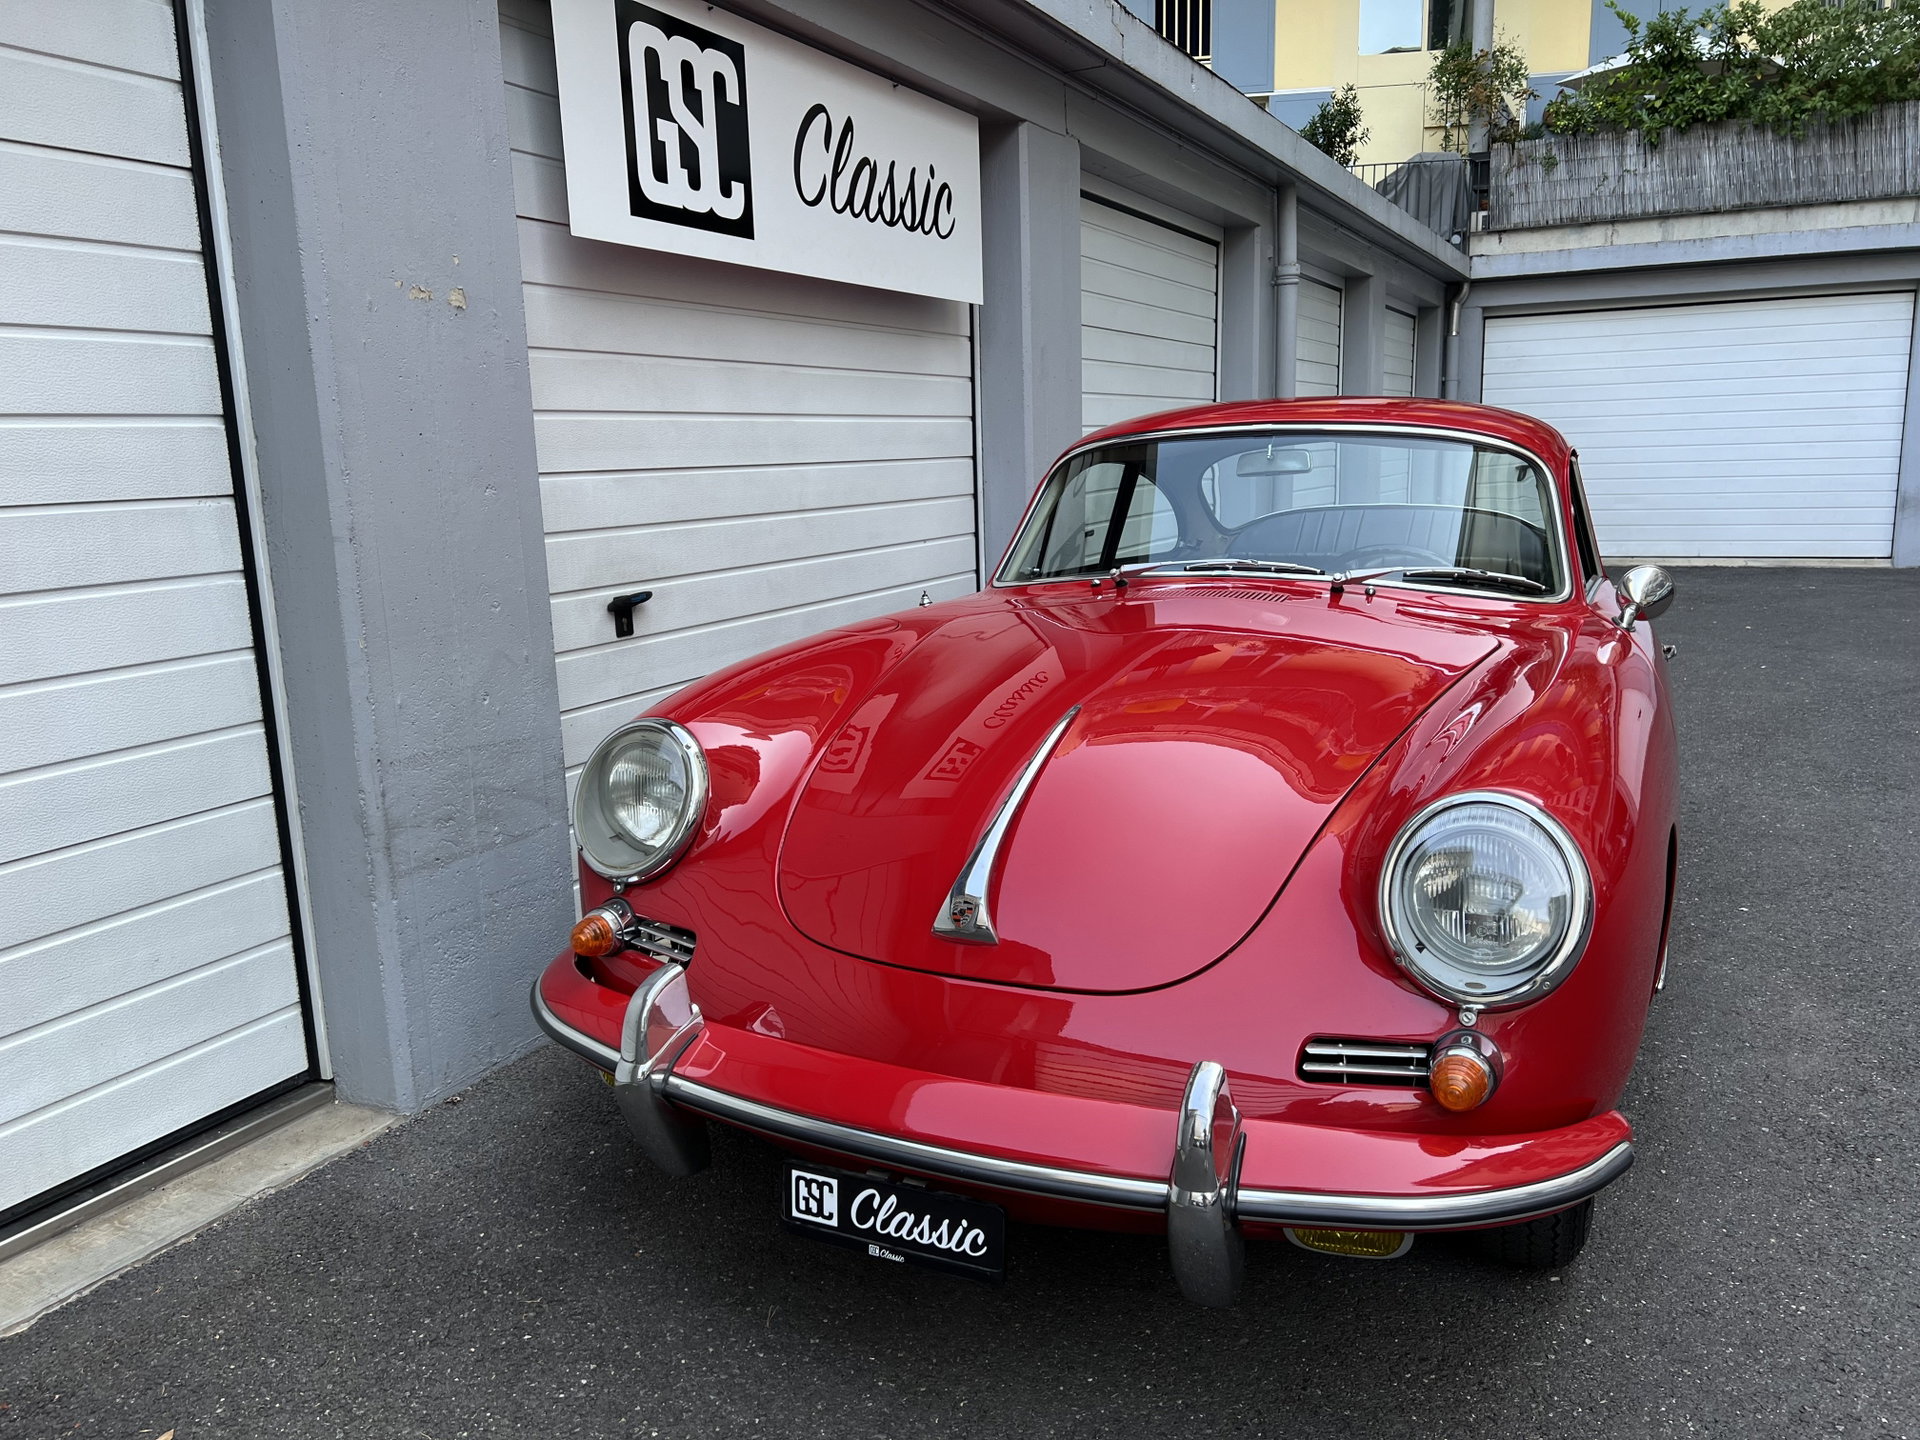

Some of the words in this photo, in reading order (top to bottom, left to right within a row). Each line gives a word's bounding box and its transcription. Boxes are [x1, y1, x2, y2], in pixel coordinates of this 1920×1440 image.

[628, 20, 745, 220] GSC
[793, 103, 956, 239] Classic
[795, 1174, 834, 1221] GSC
[850, 1188, 988, 1257] Classic
[880, 1249, 905, 1263] Classic
